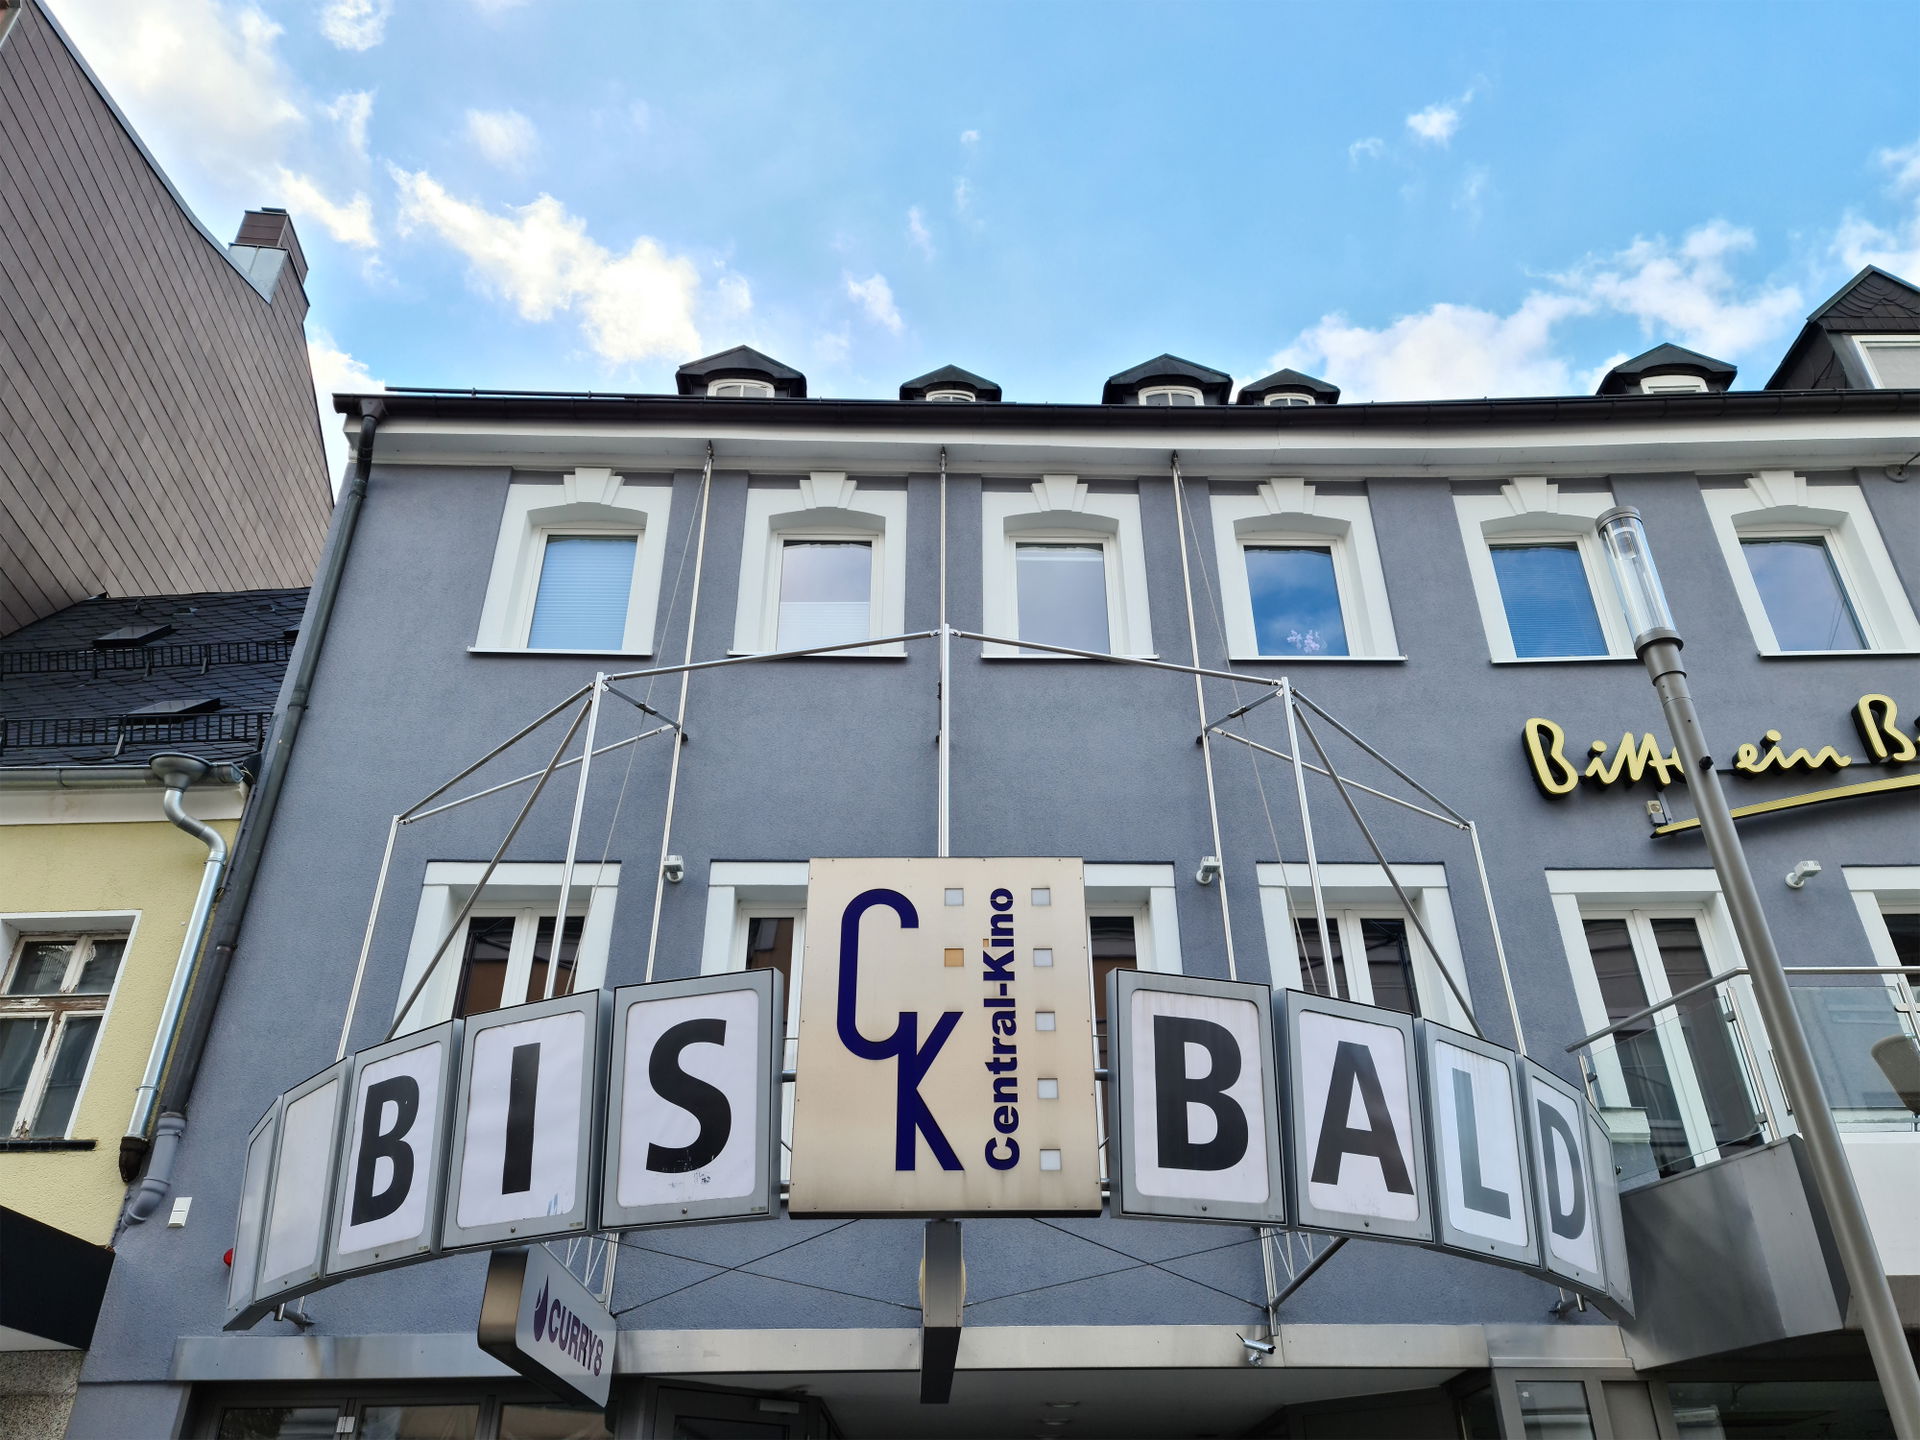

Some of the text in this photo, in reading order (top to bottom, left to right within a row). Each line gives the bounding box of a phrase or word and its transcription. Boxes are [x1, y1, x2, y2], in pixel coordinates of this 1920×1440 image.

[1736, 729, 1852, 773] ein
[1858, 693, 1920, 762] B
[350, 1014, 1586, 1240] BIS BALD
[837, 888, 965, 1171] CK
[982, 887, 1021, 1171] Central-Kino
[549, 1298, 604, 1377] CURRY8
